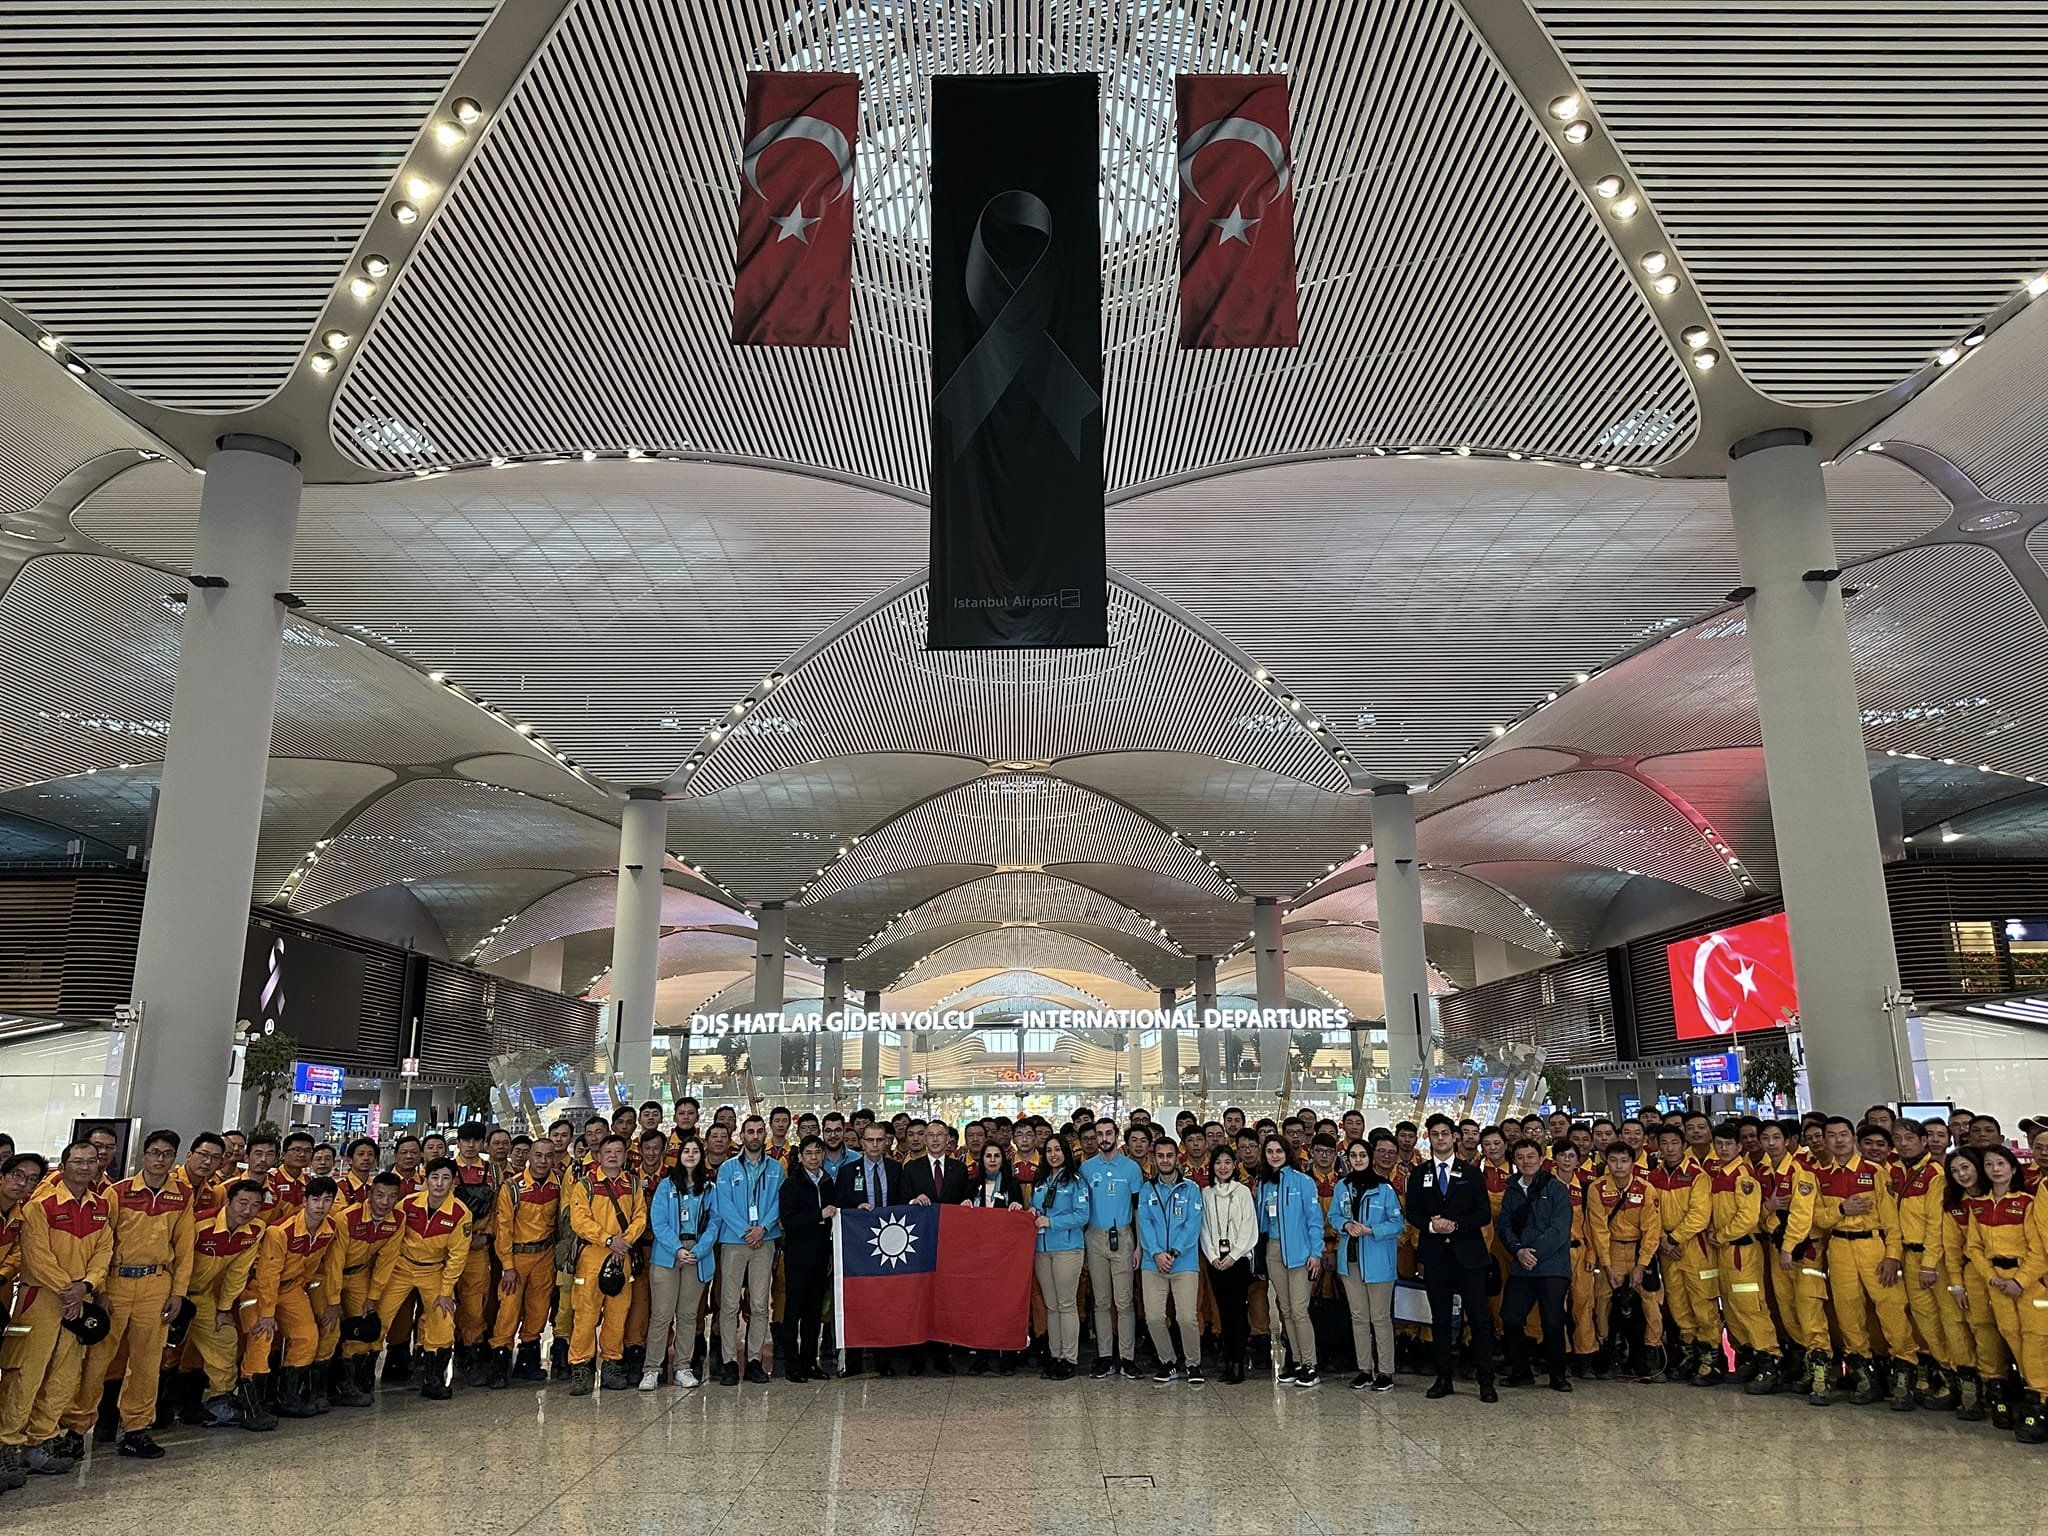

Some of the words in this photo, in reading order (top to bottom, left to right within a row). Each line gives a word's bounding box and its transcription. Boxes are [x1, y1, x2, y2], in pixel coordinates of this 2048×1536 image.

[954, 596, 1008, 608] Istanbul
[1012, 595, 1058, 608] Airport
[691, 1013, 729, 1037] DIŞ
[733, 1012, 822, 1034] HATLAR
[827, 1010, 897, 1032] GİDEN
[901, 1010, 975, 1031] YOLCU
[1023, 1007, 1200, 1029] INTERNATIONAL
[1204, 1007, 1349, 1029] DEPARTURES
